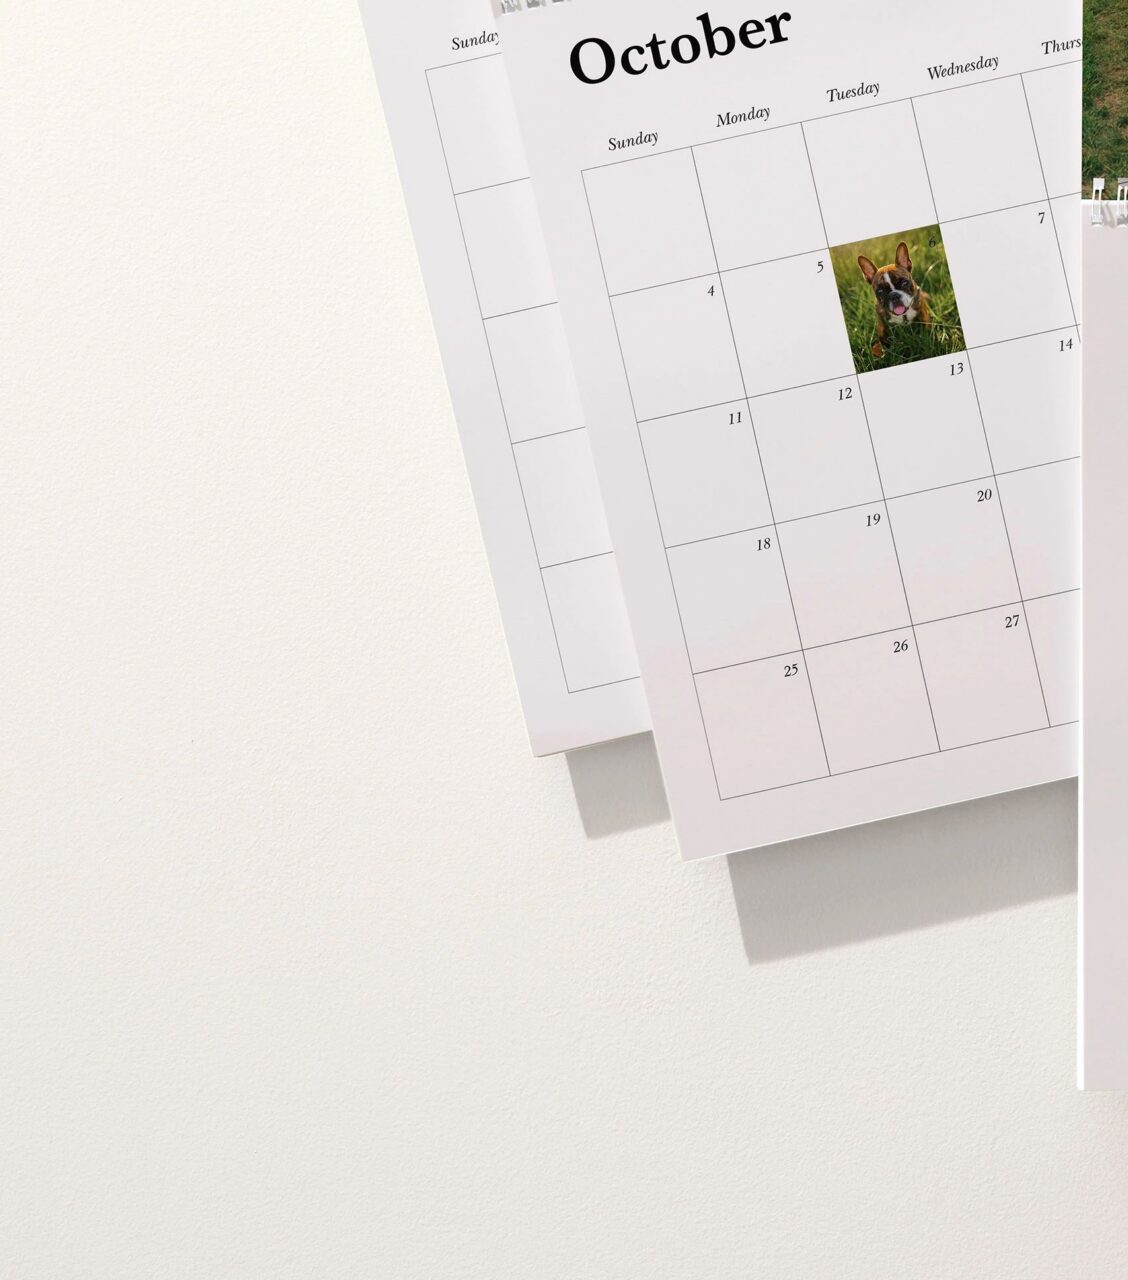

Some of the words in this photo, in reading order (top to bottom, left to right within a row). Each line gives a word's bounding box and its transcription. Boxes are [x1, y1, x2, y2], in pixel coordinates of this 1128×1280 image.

[569, 11, 792, 85] October
[607, 130, 659, 152] Sunday
[715, 105, 771, 128] Monday
[826, 81, 881, 103] Tuesday
[926, 55, 1000, 81] Wednesday
[706, 283, 716, 298] 4
[815, 259, 825, 275] 5
[1037, 210, 1047, 225] 7
[728, 410, 743, 427] 11
[837, 385, 854, 402] 12
[949, 361, 965, 378] 13
[1058, 337, 1074, 353] 14
[756, 536, 772, 553] 18
[865, 511, 882, 528] 19
[975, 487, 994, 504] 20
[782, 662, 800, 679] 25
[892, 637, 910, 655] 26
[1003, 613, 1021, 630] 27
